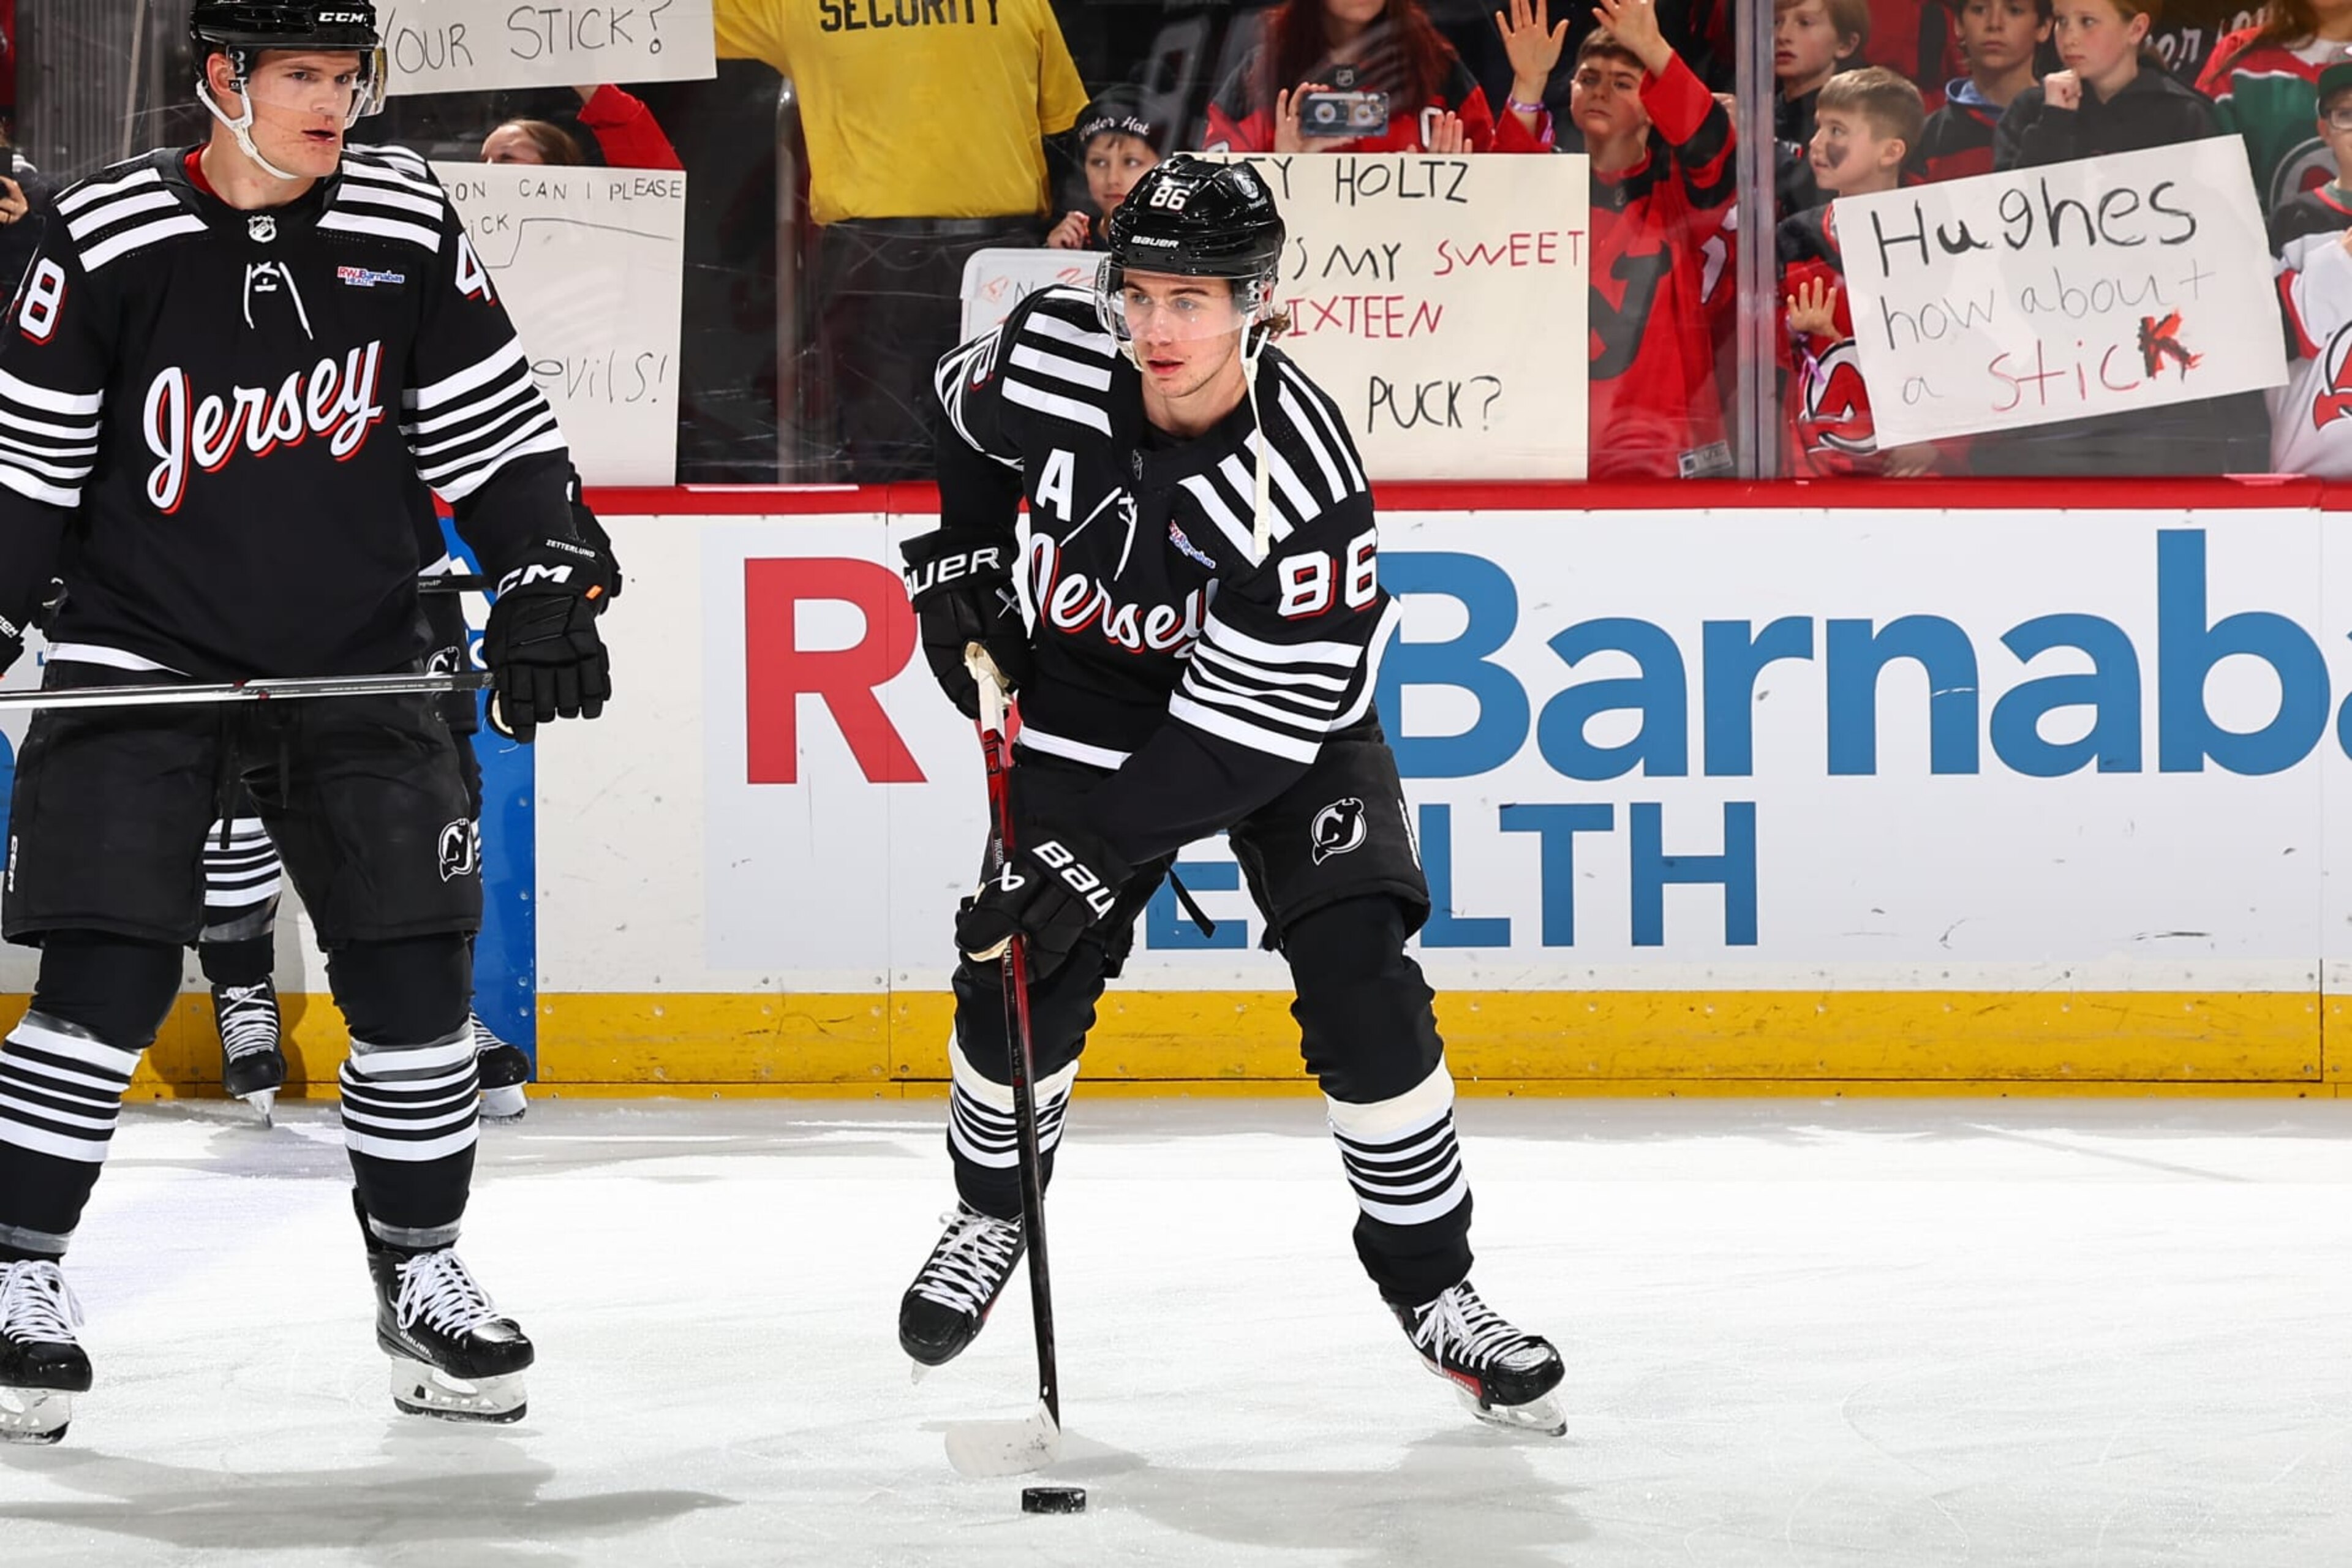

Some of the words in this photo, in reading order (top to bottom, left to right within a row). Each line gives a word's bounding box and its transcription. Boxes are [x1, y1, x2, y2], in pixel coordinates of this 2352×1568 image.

[318, 12, 368, 27] CCM
[377, 7, 473, 73] YOUR
[507, 0, 674, 59] STICK?
[820, 0, 998, 31] SECURITY
[1121, 116, 1150, 136] Hat
[519, 178, 567, 201] CAN
[586, 178, 590, 200] I
[610, 179, 682, 202] PLEASE
[1150, 186, 1190, 211] 86
[1336, 157, 1468, 206] HOLTZ
[464, 214, 510, 241] iCK
[1871, 178, 2196, 277] Hughes
[1322, 243, 1401, 282] MY
[1433, 230, 1585, 276] SWEET
[1270, 295, 1443, 341] IXTEEN
[1880, 286, 1995, 350] how
[2020, 260, 2216, 318] about
[1368, 375, 1502, 434] PUCK?
[1902, 375, 1944, 405] a
[143, 340, 383, 516] Jersey
[1036, 448, 1075, 522] A
[546, 539, 596, 558] ZETTERLUND
[1278, 527, 1378, 620] 86
[1147, 801, 1757, 949] ELTH
